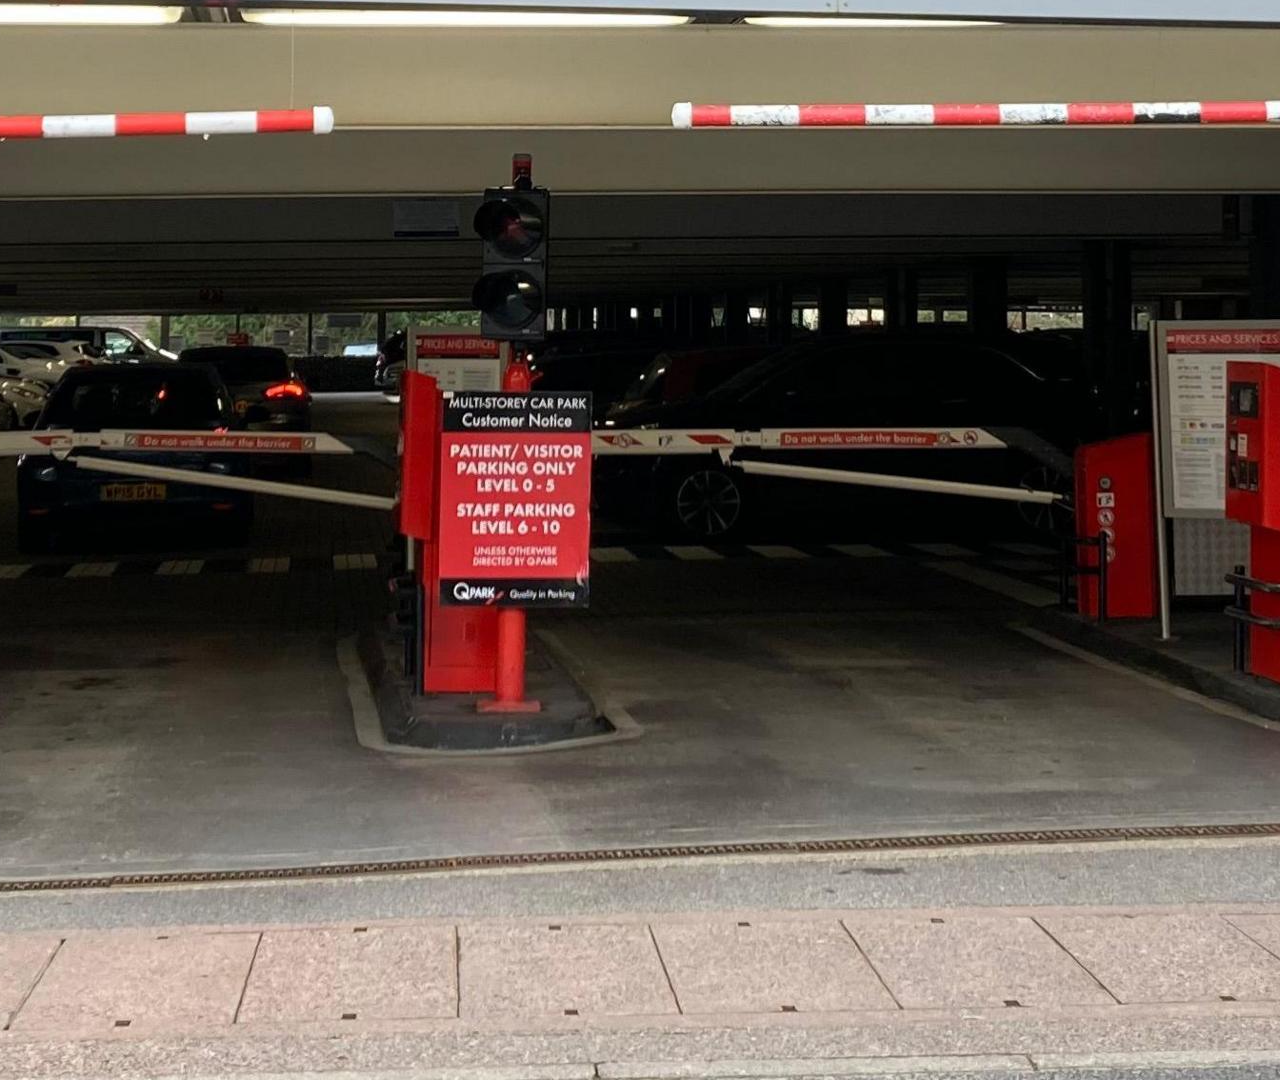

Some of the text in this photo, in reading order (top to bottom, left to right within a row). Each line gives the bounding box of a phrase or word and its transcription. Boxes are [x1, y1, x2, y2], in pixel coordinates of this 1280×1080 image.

[423, 338, 496, 349] PRICES AND SERVICES
[1175, 333, 1280, 345] PRICES AND SERVICES
[449, 397, 587, 410] MULTI-STOREY CAR PARK
[461, 413, 573, 429] Customer Notice
[143, 435, 291, 450] Do not walk under the barrier
[784, 433, 928, 445] Do not walk under the barrier
[449, 443, 584, 459] PATIENT/ VISITOR
[456, 461, 577, 476] PARKING ONLY
[476, 478, 520, 493] LEVEL
[522, 478, 534, 493] 0
[545, 478, 556, 493] 5
[456, 503, 576, 518] STAFF PARKING
[471, 521, 514, 535] LEVEL
[517, 521, 529, 535] 6
[542, 521, 561, 535] 10
[473, 546, 557, 557] UNLESS OTHERWISE
[472, 556, 514, 568] DIRECTED
[514, 556, 526, 567] BY
[509, 589, 538, 602] Quality
[538, 589, 547, 600] in
[547, 589, 576, 601] Parking
